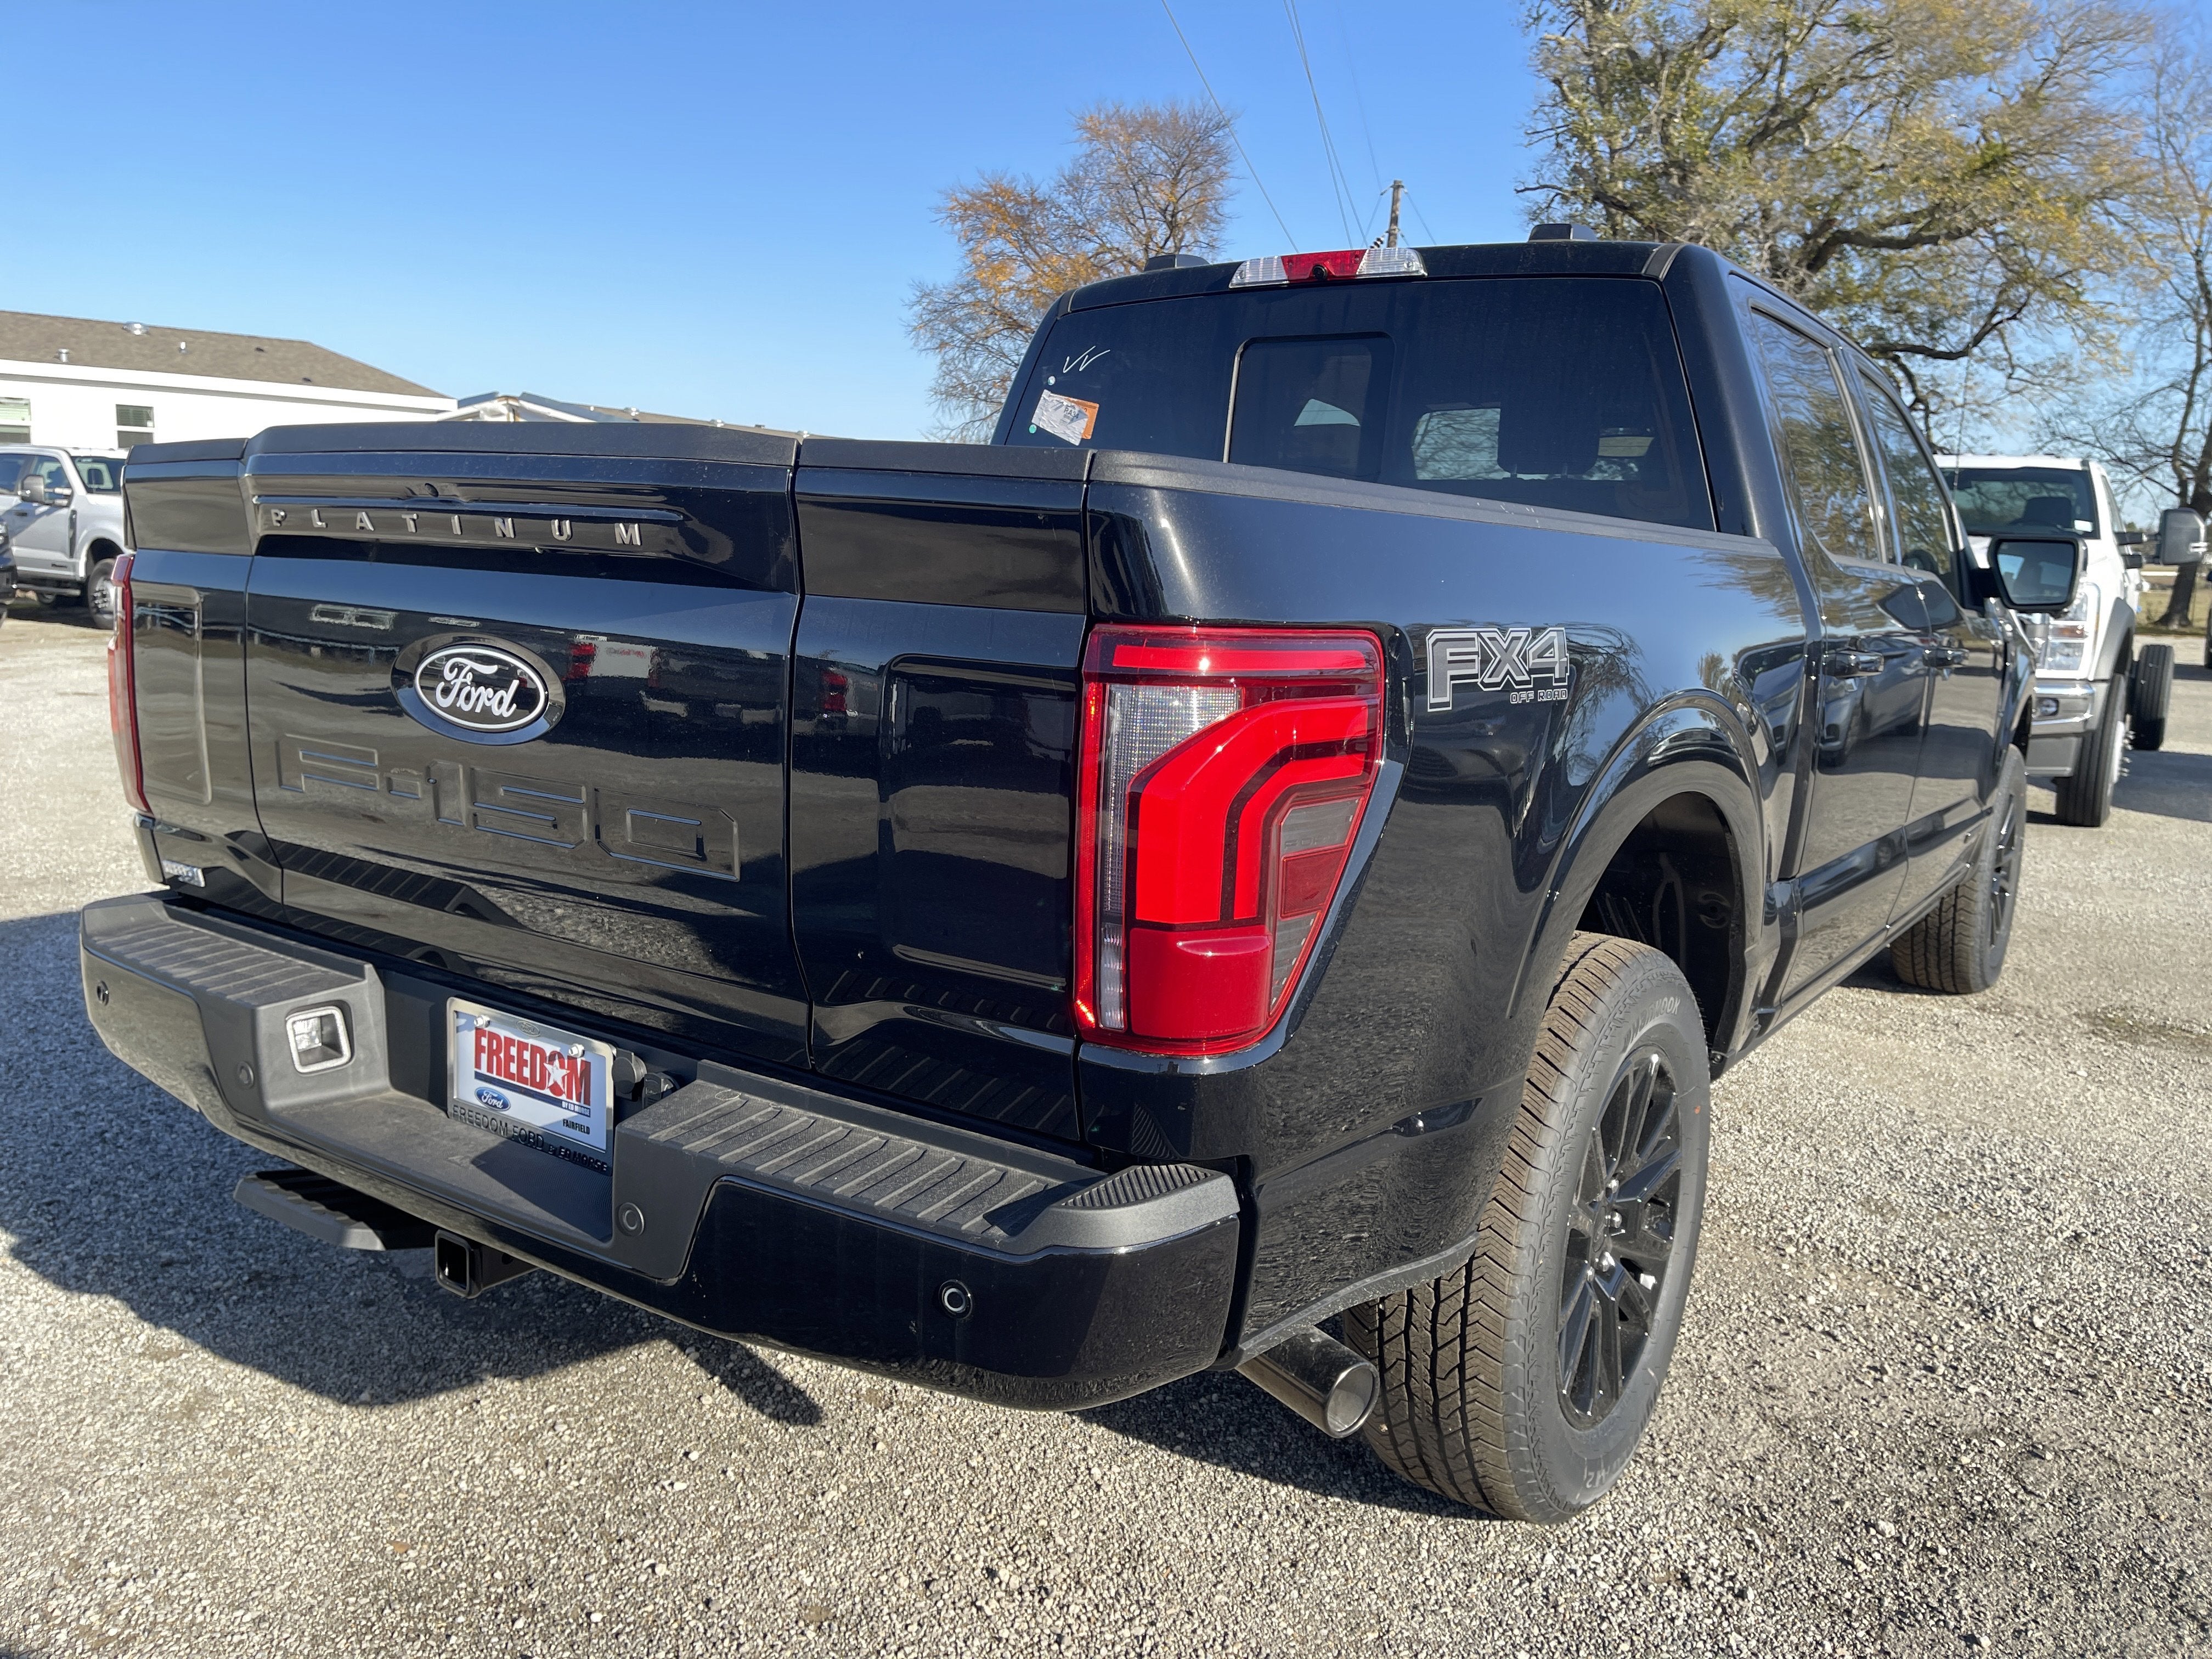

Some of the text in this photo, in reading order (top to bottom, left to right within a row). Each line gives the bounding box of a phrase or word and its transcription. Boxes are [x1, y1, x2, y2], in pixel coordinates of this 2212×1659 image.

[270, 508, 641, 546] PLATINUM
[436, 657, 520, 718] Ford
[1426, 627, 1569, 712] FX4
[1510, 689, 1567, 703] OFF ROAD
[275, 733, 740, 882] F-150
[474, 1027, 591, 1105] FREEDOM
[481, 1090, 504, 1108] Ford
[453, 1105, 508, 1137] FREEDOM
[512, 1125, 544, 1150] FORD
[563, 1119, 590, 1135] FAIRFIELD
